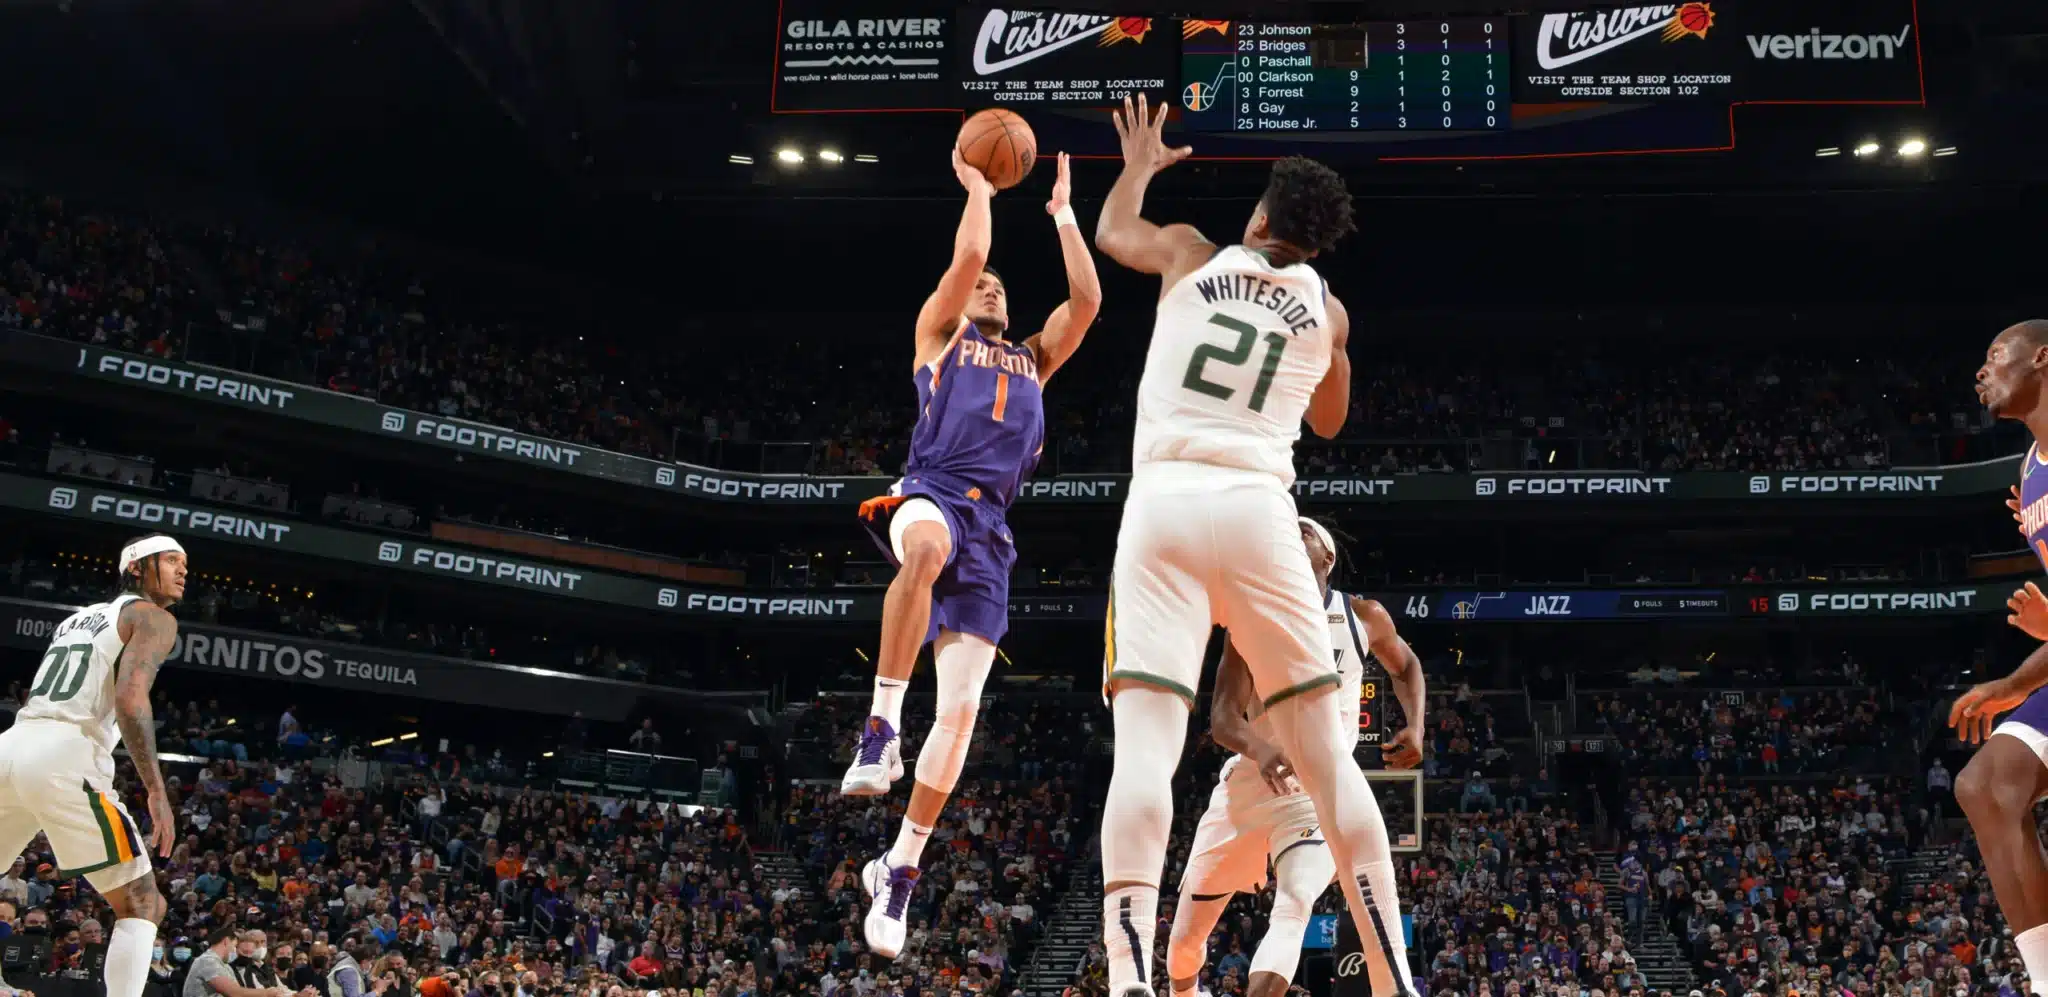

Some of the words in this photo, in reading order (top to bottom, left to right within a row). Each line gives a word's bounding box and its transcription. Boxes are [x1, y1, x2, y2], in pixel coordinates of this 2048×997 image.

[787, 20, 851, 39] GILA
[858, 18, 941, 37] RIVER
[1238, 25, 1254, 35] 23
[1259, 24, 1311, 35] Johnson
[1396, 24, 1405, 34] 3
[1440, 23, 1449, 34] 0
[1484, 23, 1492, 34] 0
[785, 42, 855, 51] RESORTS
[862, 42, 871, 50] &
[877, 41, 944, 49] CASINOS
[1238, 40, 1254, 51] 25
[1259, 40, 1306, 53] Bridges
[1396, 40, 1405, 50] 3
[1442, 40, 1448, 50] 1
[1486, 40, 1492, 50] 1
[1746, 28, 1895, 59] verizon
[1242, 57, 1250, 67] 0
[1259, 56, 1311, 67] Paschall
[1398, 56, 1404, 65] 1
[1441, 55, 1450, 65] 0
[1486, 55, 1492, 64] 1
[871, 74, 889, 82] pass
[1238, 72, 1254, 82] 00
[1259, 71, 1313, 82] Clarkson
[1350, 71, 1358, 81] 9
[1398, 71, 1404, 81] 1
[1441, 70, 1450, 81] 2
[1487, 70, 1493, 80] 1
[1528, 76, 1565, 84] VISIT
[1572, 76, 1594, 84] THE
[1601, 76, 1630, 84] TEAM
[1637, 76, 1666, 84] SHOP
[1673, 75, 1731, 84] LOCATION
[962, 81, 999, 90] VISIT
[1006, 81, 1027, 90] THE
[1034, 80, 1064, 89] TEAM
[1070, 80, 1099, 89] SHOP
[1106, 79, 1164, 88] LOCATION
[1242, 88, 1250, 98] 3
[1259, 87, 1303, 98] Forrest
[1350, 86, 1358, 97] 9
[1399, 86, 1405, 97] 1
[1442, 86, 1450, 96] 0
[1486, 85, 1494, 95] 0
[1561, 87, 1612, 96] OUTSIDE
[1619, 87, 1670, 95] SECTION
[1678, 86, 1699, 95] 102
[994, 92, 1045, 101] OUTSIDE
[1052, 91, 1102, 100] SECTION
[1110, 90, 1131, 99] 102
[1242, 103, 1250, 114] 8
[1259, 102, 1285, 116] Gay
[1350, 102, 1358, 112] 2
[1399, 102, 1405, 112] 1
[1442, 102, 1451, 112] 0
[1486, 101, 1495, 111] 0
[1237, 119, 1254, 130] 25
[1259, 118, 1300, 129] House
[1302, 118, 1317, 129] Jr.
[1350, 117, 1358, 127] 5
[1398, 117, 1406, 127] 3
[1443, 117, 1451, 127] 0
[1487, 117, 1495, 127] 0
[1196, 274, 1318, 336] WHITESIDE
[957, 339, 1040, 388] PHOENIX
[1182, 312, 1288, 413] 21
[99, 355, 294, 409] FOOTPRINT
[992, 373, 1009, 422] 1
[416, 419, 582, 465] FOOTPRINT
[684, 474, 844, 499] FOOTPRINT
[1508, 478, 1671, 494] FOOTPRINT
[1782, 476, 1943, 493] FOOTPRINT
[91, 496, 290, 543] FOOTPRINT
[413, 549, 582, 591] FOOTPRINT
[687, 593, 854, 616] FOOTPRINT
[1067, 604, 1073, 612] 2
[1405, 596, 1429, 618] 46
[1524, 596, 1571, 615] JAZZ
[1634, 600, 1640, 608] 0
[1679, 600, 1685, 608] 5
[1750, 598, 1769, 612] 15
[1811, 591, 1976, 611] FOOTPRINT
[29, 643, 93, 702] 00
[334, 659, 418, 686] TEQUILA
[1726, 694, 1740, 705] 121
